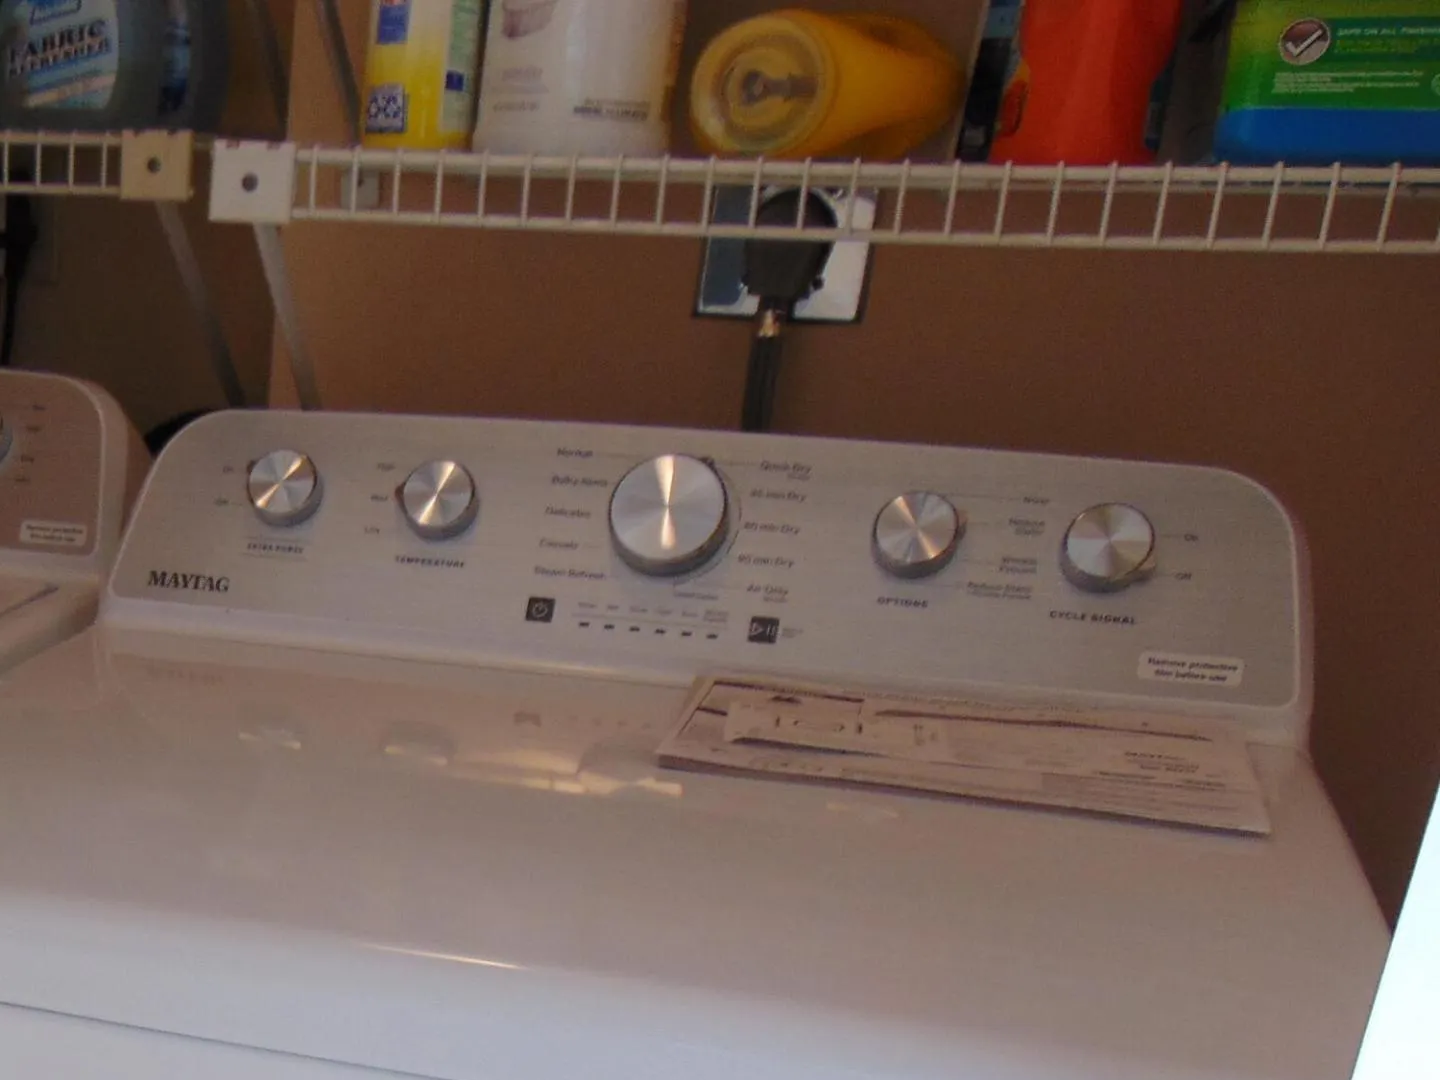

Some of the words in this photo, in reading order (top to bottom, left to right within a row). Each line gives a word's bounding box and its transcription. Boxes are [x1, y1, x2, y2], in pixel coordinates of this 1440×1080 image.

[792, 463, 812, 475] Dry
[787, 491, 806, 503] Dry
[780, 524, 800, 536] Dry
[394, 555, 465, 568] TEMPERATURE
[774, 556, 795, 569] Dry
[148, 570, 230, 592] MAYTAG
[877, 596, 929, 609] OPTIONS
[1049, 610, 1086, 622] CYCLE
[1091, 613, 1136, 625] SIGNAL
